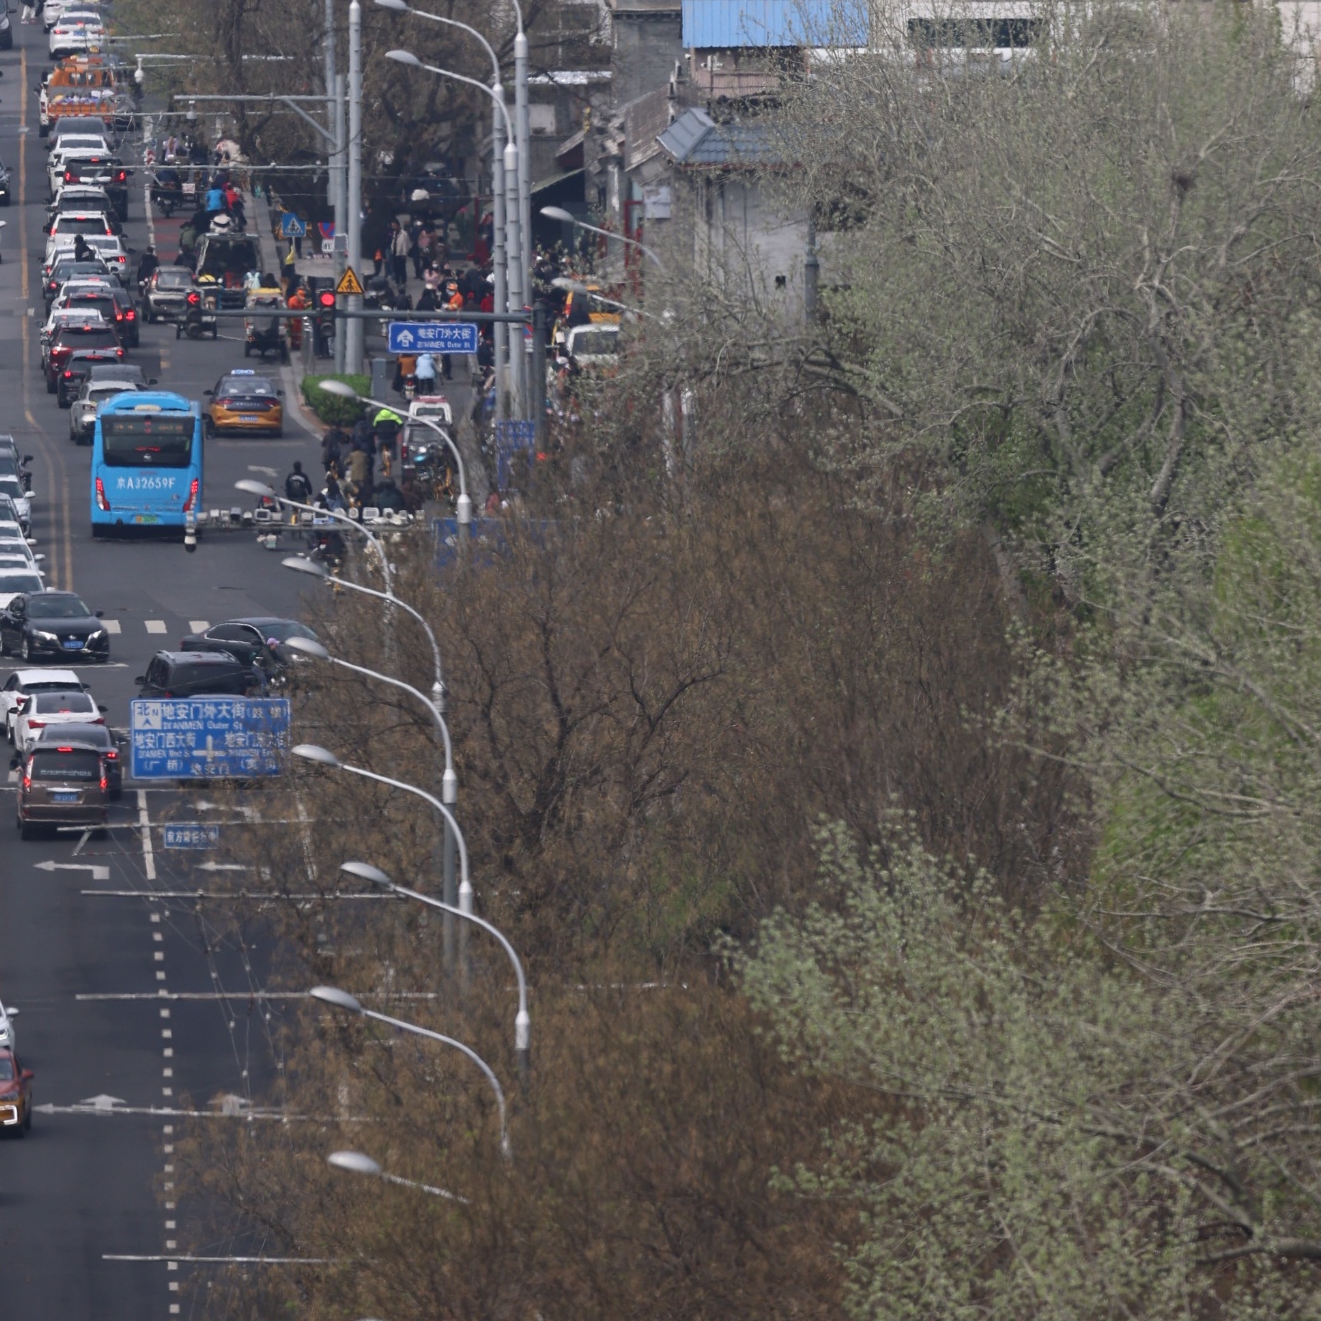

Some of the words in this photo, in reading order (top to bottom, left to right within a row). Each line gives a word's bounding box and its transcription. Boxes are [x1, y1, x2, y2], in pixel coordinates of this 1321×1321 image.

[418, 328, 471, 339] 地安门外大街
[116, 476, 176, 489] 京A32659F
[137, 703, 151, 717] 北
[161, 703, 246, 720] 地安门外大街
[134, 732, 196, 748] 地安门西大街
